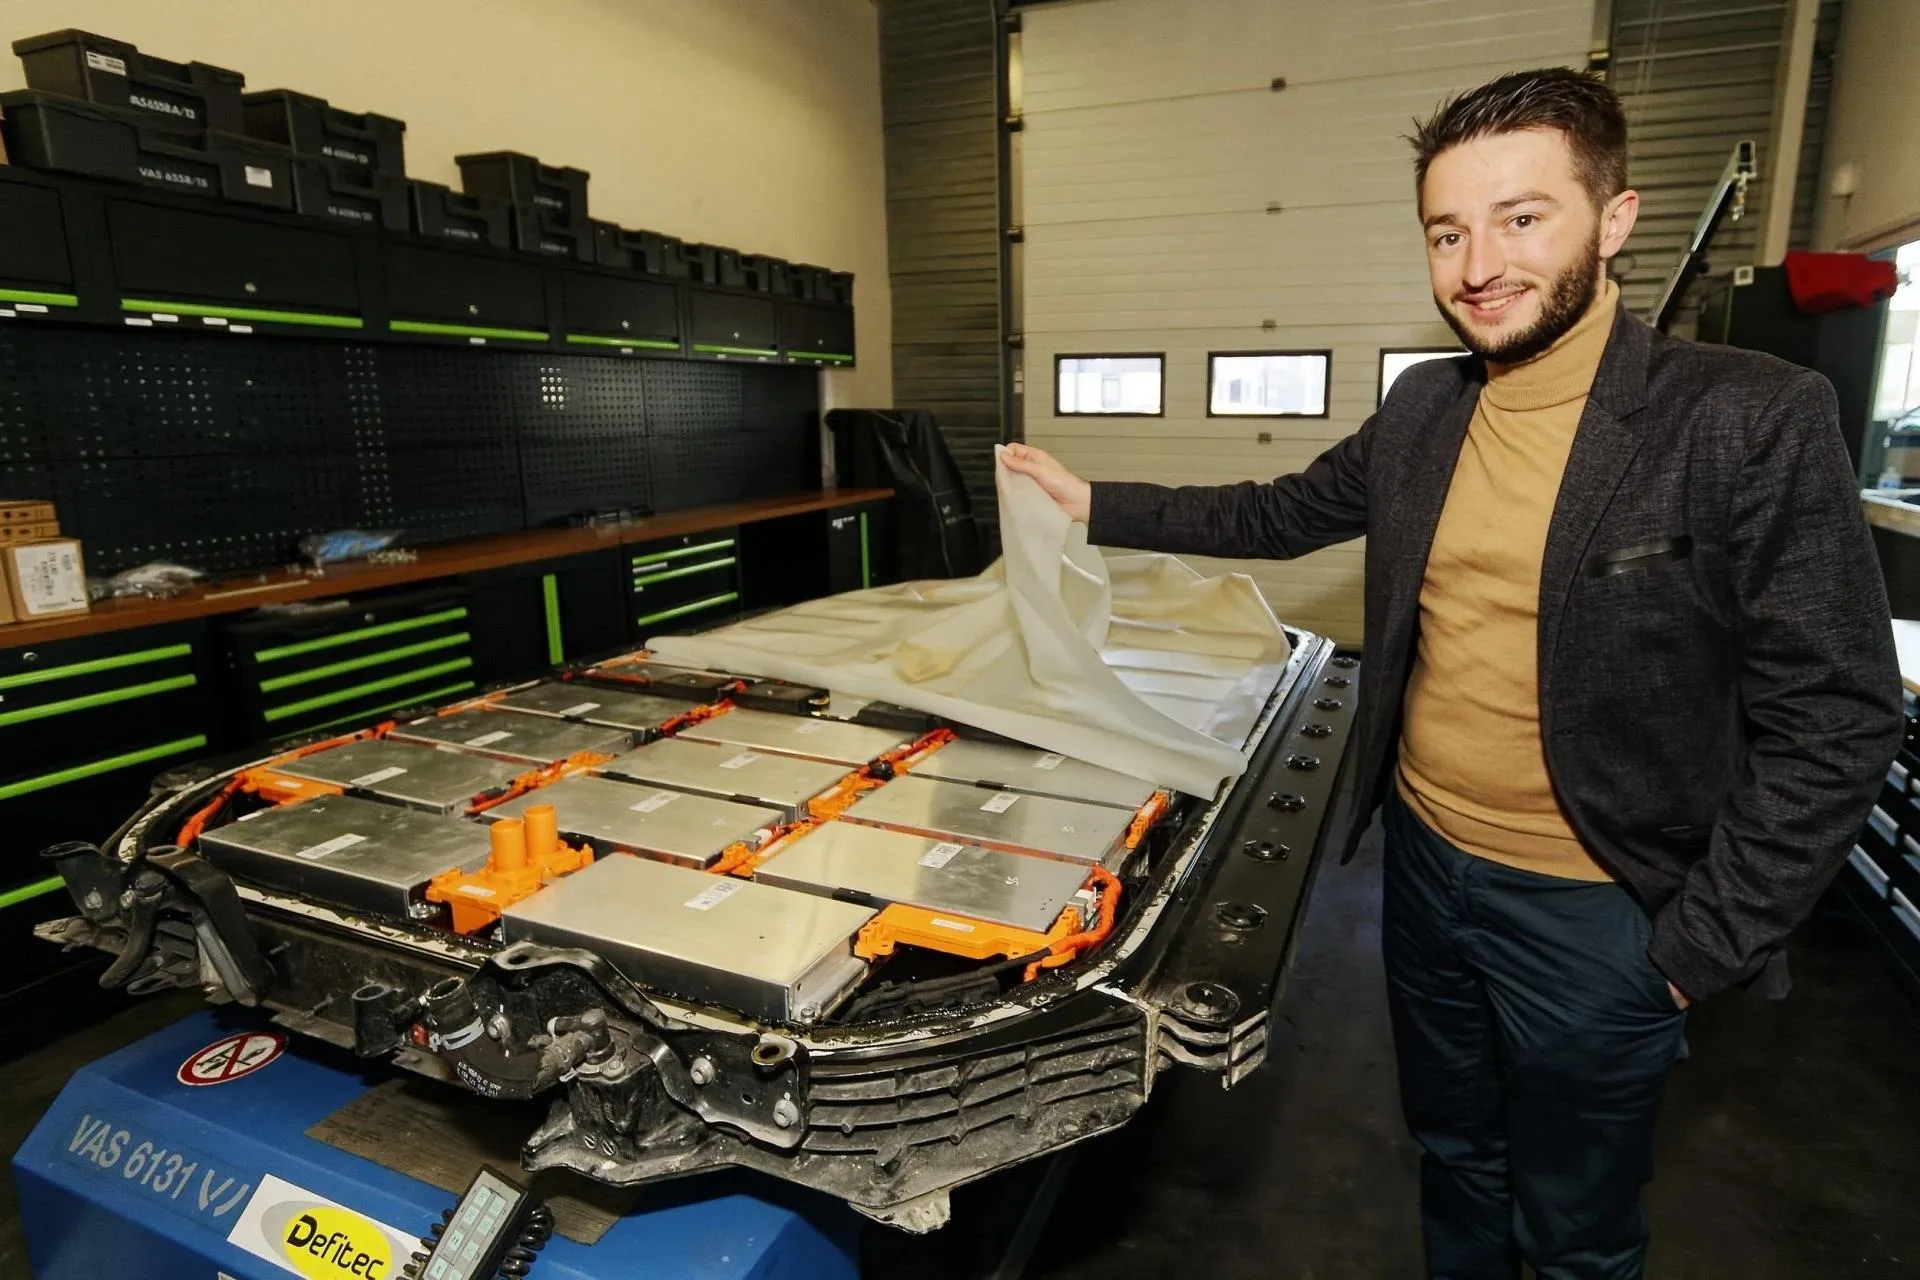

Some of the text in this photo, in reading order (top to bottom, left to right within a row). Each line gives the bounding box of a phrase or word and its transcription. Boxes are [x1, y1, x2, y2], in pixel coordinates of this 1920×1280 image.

[138, 166, 162, 180] VAS
[67, 1114, 131, 1168] VAS
[123, 1141, 198, 1199] 6131
[286, 1214, 384, 1280] Defitec
